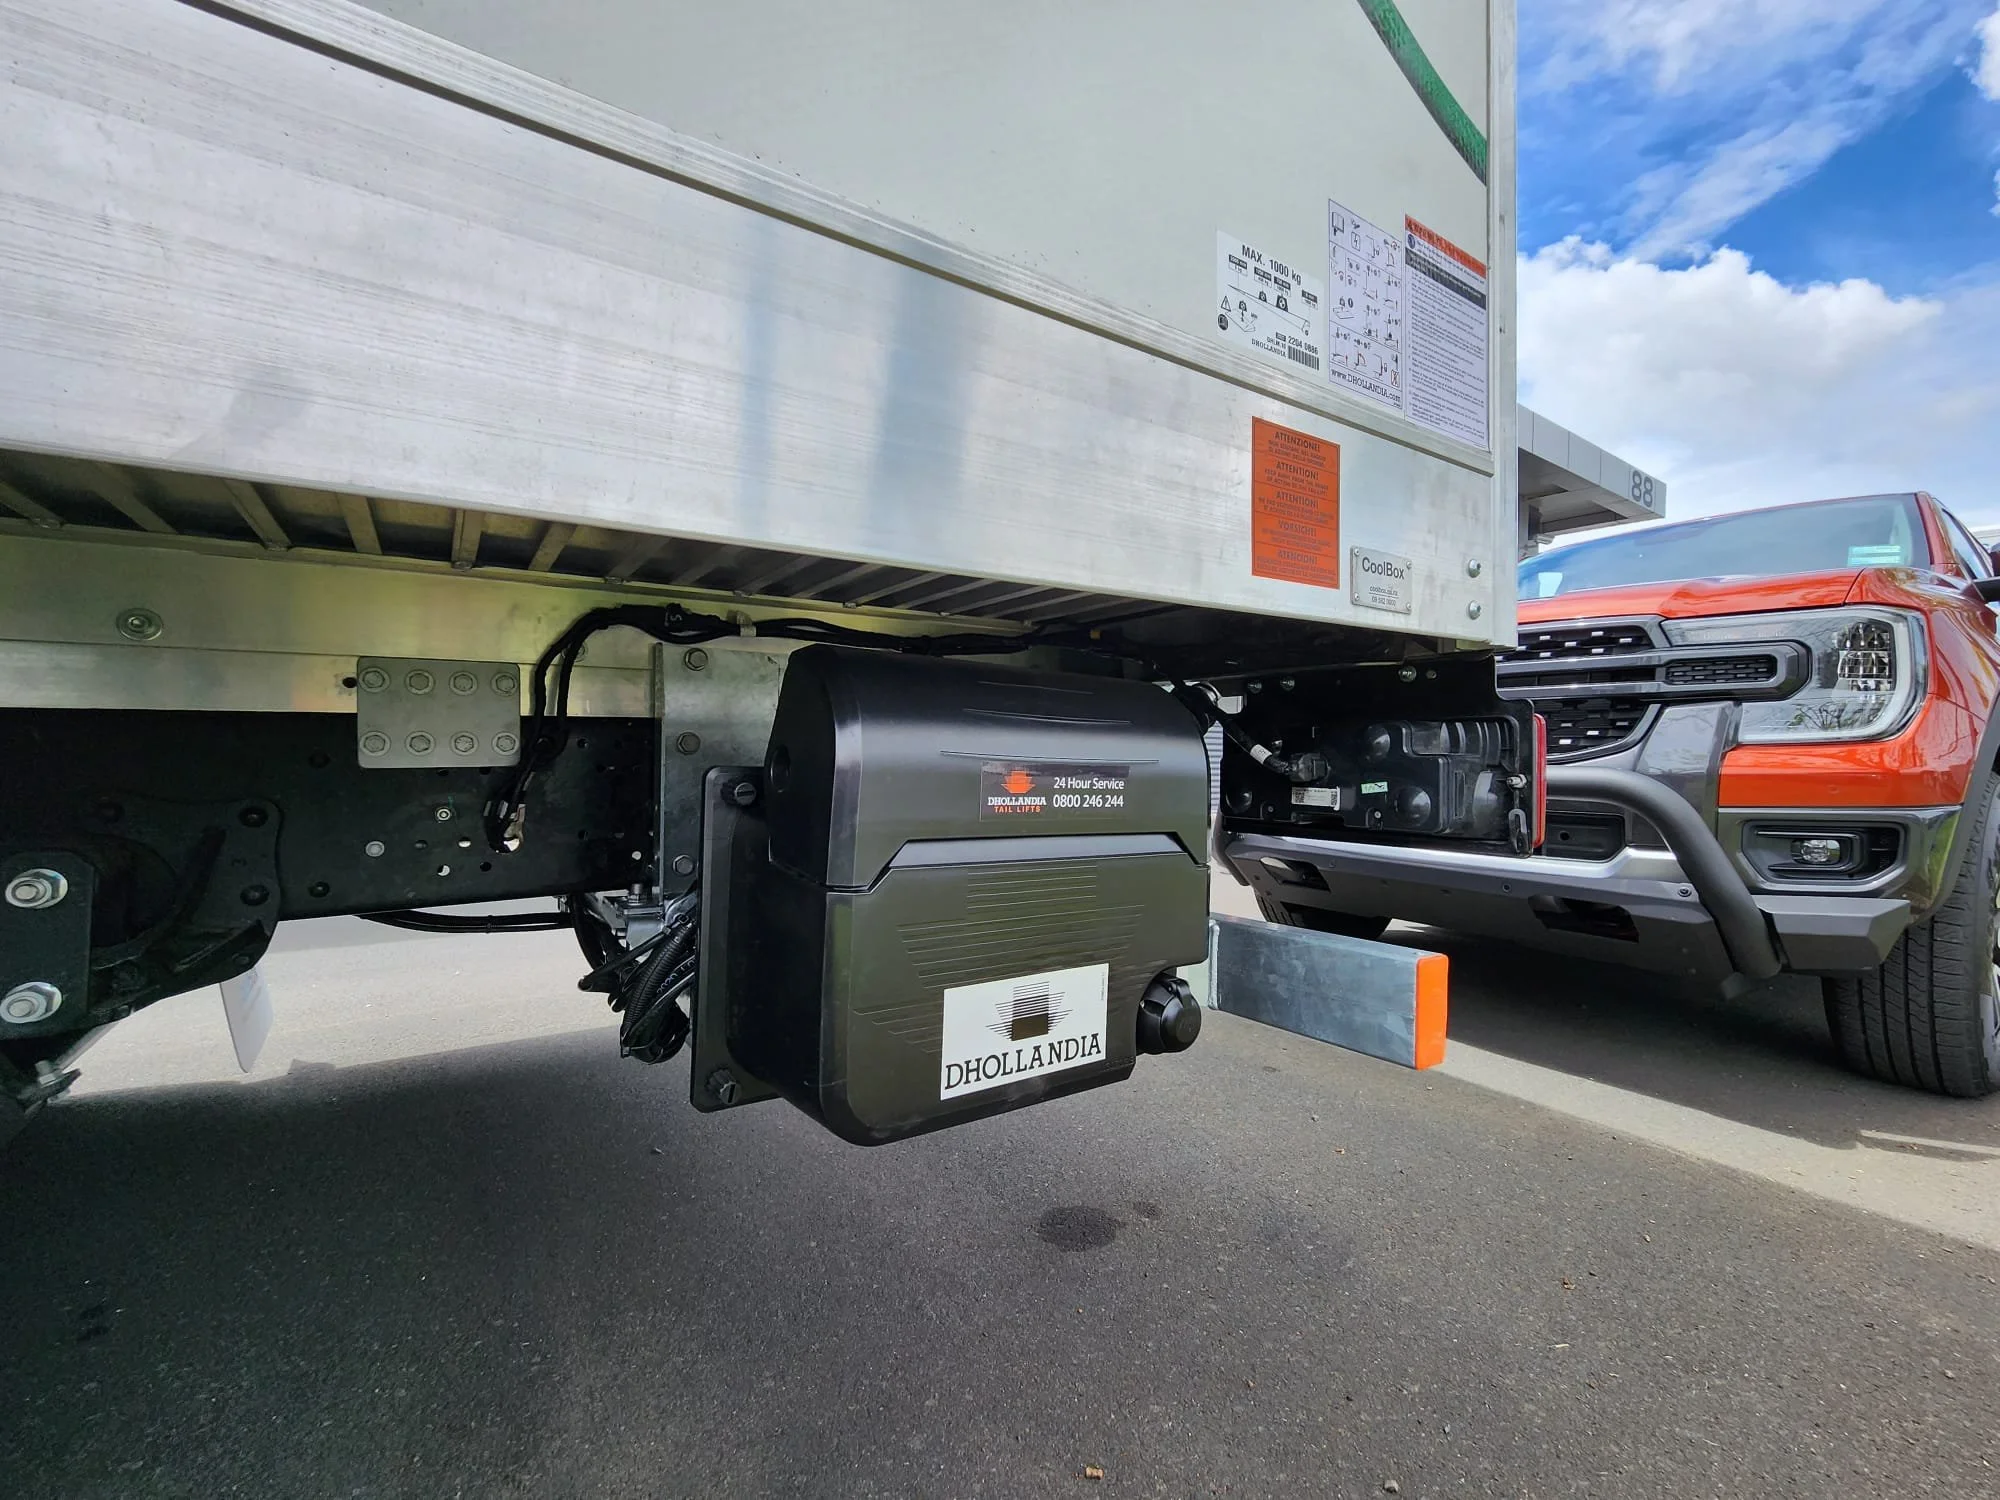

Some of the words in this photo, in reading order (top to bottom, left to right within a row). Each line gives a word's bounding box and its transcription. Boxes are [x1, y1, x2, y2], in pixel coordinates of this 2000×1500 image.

[1242, 244, 1265, 266] MAX.
[1269, 259, 1289, 278] 1000
[1291, 269, 1302, 286] kg
[1251, 338, 1287, 358] DHOLLANDIA
[1330, 368, 1401, 403] www.DHOLLANDIA.com
[1274, 431, 1320, 452] ATTENZIONE!
[1276, 460, 1319, 480] ATTENTION!
[1632, 470, 1653, 508] 88
[1276, 491, 1319, 509] ATTENTION!
[1362, 556, 1405, 580] CoolBox
[1053, 777, 1066, 789] 24
[1067, 777, 1092, 789] Hour
[1092, 777, 1125, 790] Service
[987, 796, 1047, 806] DHOLLANDIA
[994, 805, 1013, 813] TAIL
[1016, 805, 1041, 813] LIFTS
[1052, 794, 1081, 808] 0800
[1082, 794, 1103, 808] 246
[1104, 794, 1124, 808] 244
[944, 1032, 1102, 1090] DHOLLANDIA
